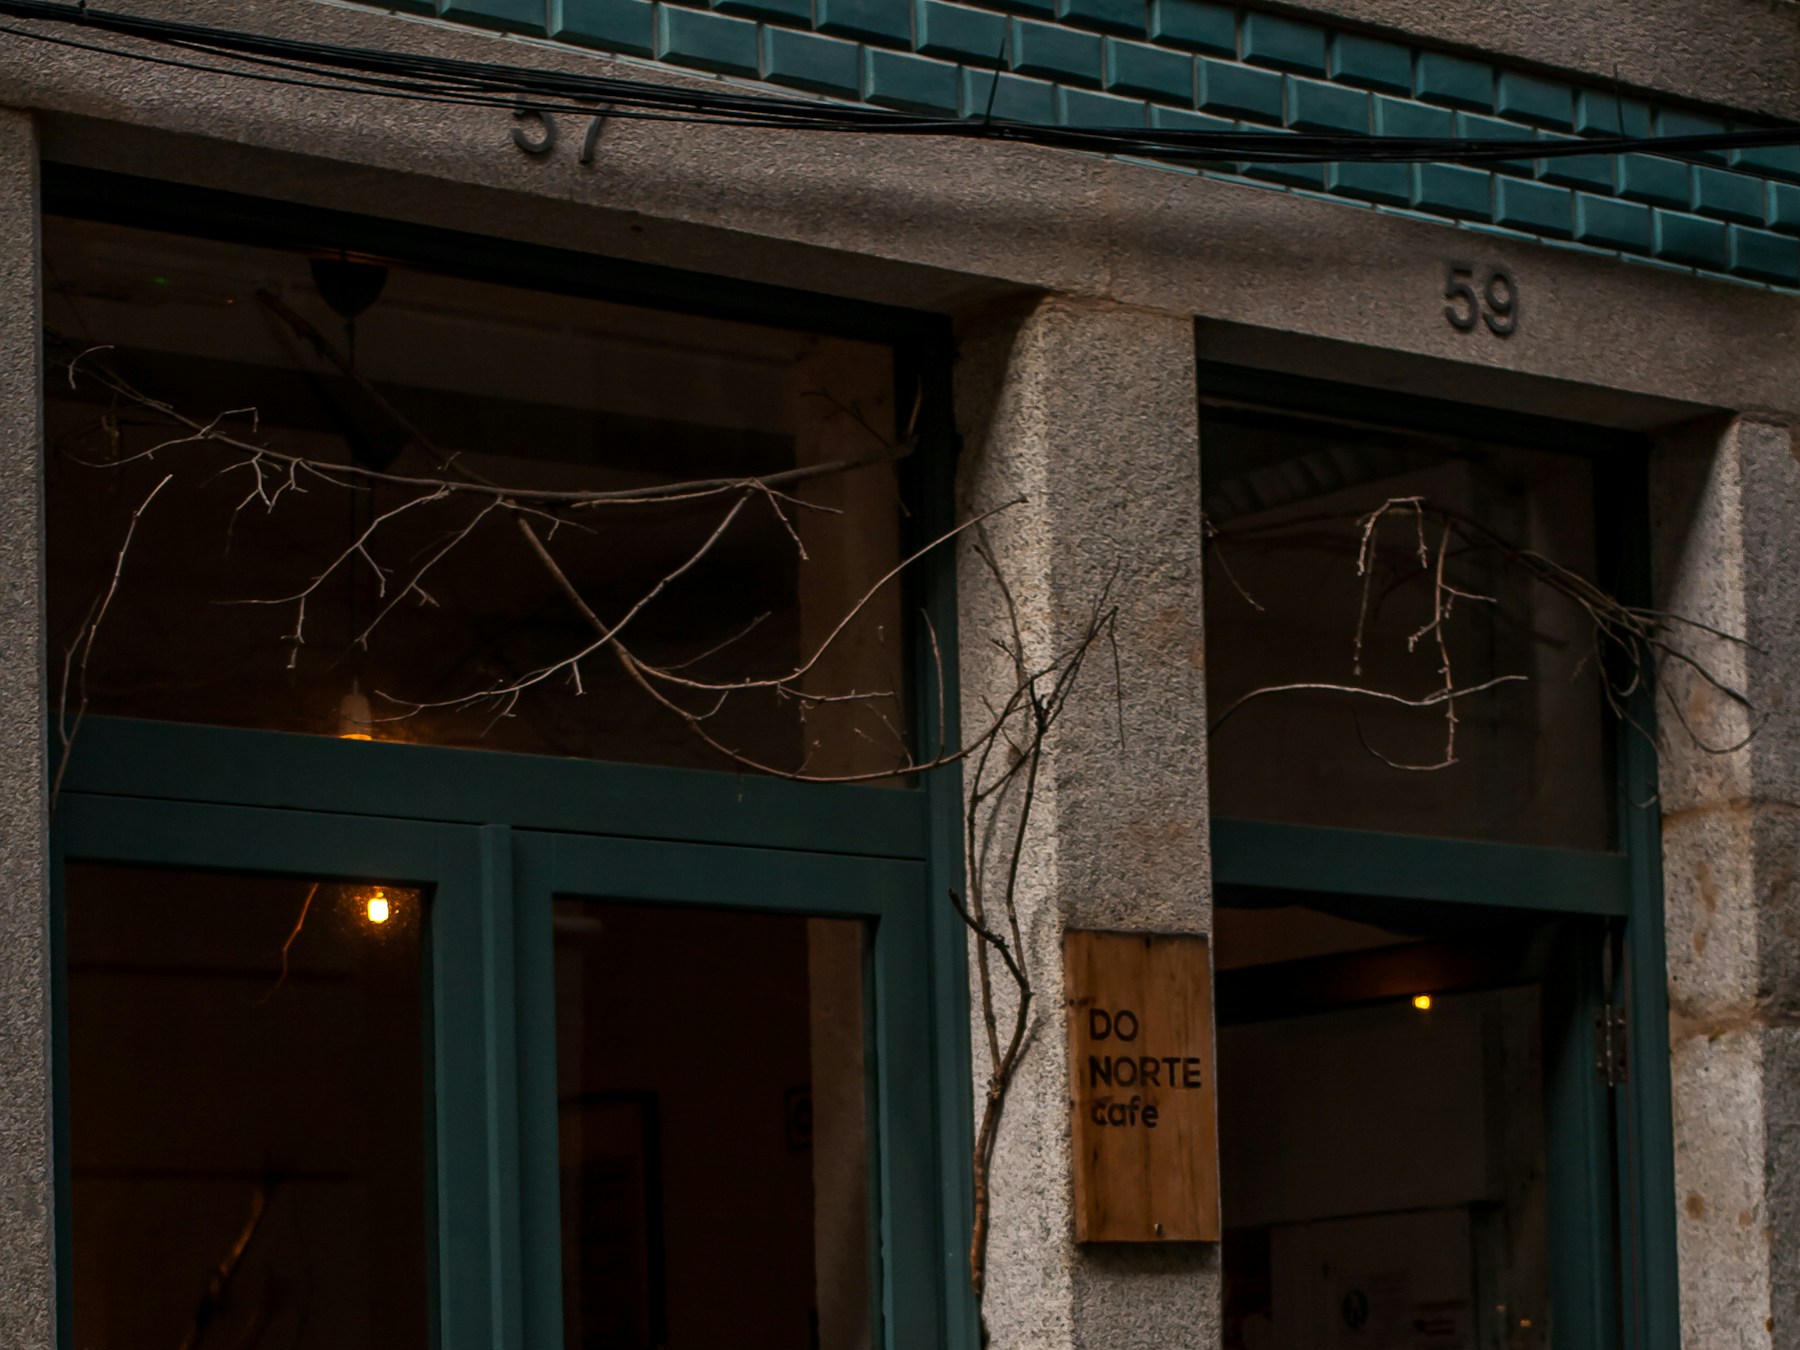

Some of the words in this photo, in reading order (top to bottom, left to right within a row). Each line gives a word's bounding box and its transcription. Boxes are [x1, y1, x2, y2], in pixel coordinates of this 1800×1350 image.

[1442, 257, 1518, 335] 59
[1089, 1008, 1139, 1041] DO
[1088, 1055, 1202, 1088] NORTE
[1091, 1095, 1159, 1128] cafe
